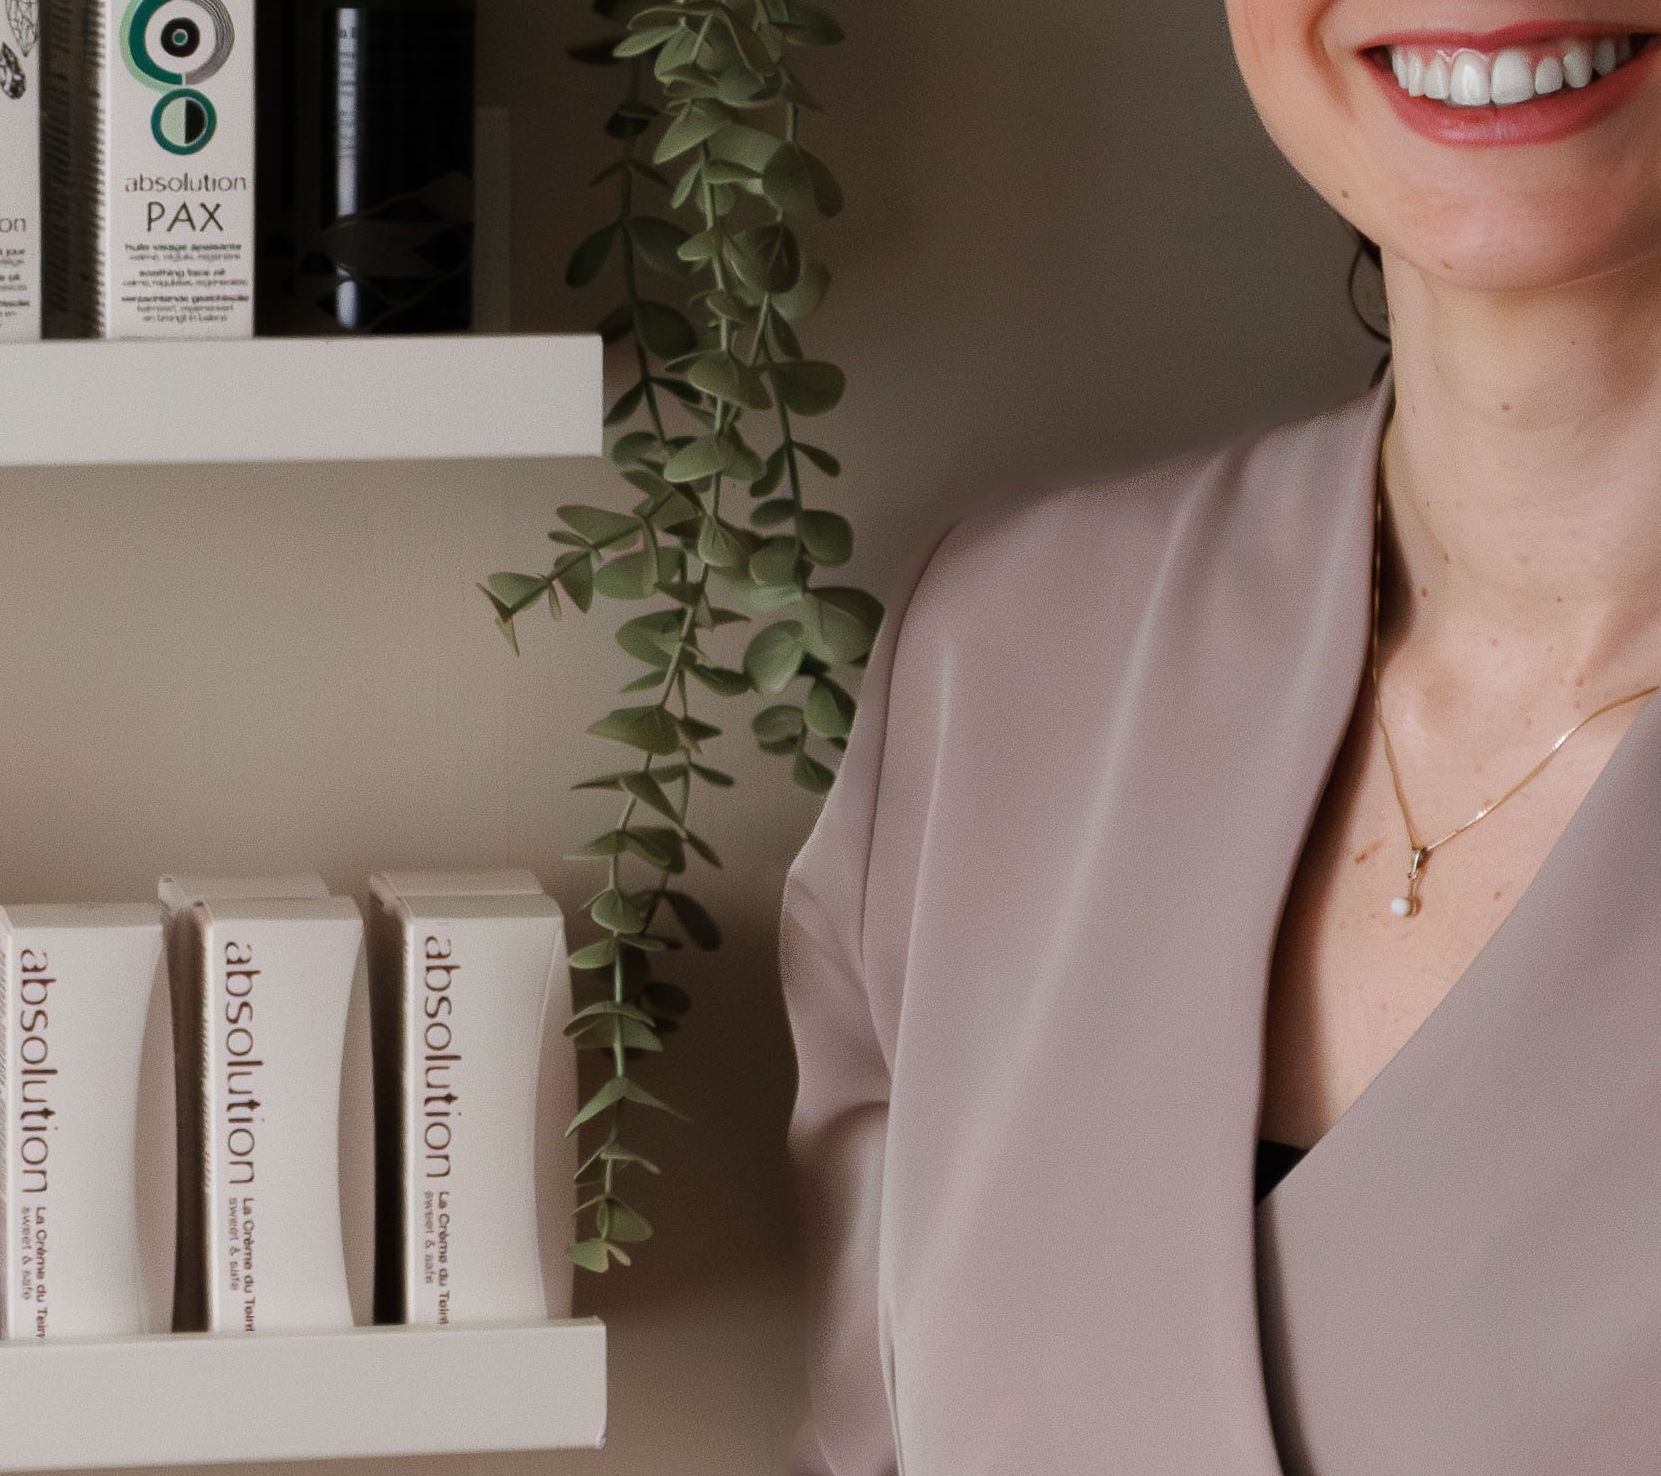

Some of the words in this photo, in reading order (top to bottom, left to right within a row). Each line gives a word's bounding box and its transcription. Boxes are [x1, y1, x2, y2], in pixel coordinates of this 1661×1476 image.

[125, 173, 247, 192] absolution
[147, 201, 224, 232] PAX
[20, 948, 58, 1193] absolution
[225, 941, 265, 1184] absolution
[423, 935, 462, 1178] absolution
[36, 1206, 47, 1224] La
[243, 1197, 254, 1215] La
[424, 1190, 434, 1234] sweet
[439, 1191, 450, 1209] La
[22, 1206, 32, 1250] sweet
[229, 1197, 239, 1241] sweet
[229, 1246, 240, 1256] &
[243, 1220, 255, 1270] Crème
[425, 1239, 436, 1248] &
[439, 1213, 450, 1263] Crème
[22, 1255, 33, 1265] &
[36, 1229, 47, 1280] Crème
[425, 1254, 436, 1284] safe
[22, 1270, 33, 1300] safe
[229, 1261, 240, 1291] safe
[243, 1275, 255, 1293] du
[439, 1268, 449, 1286] du
[36, 1284, 47, 1303] du
[36, 1307, 48, 1338] Tein
